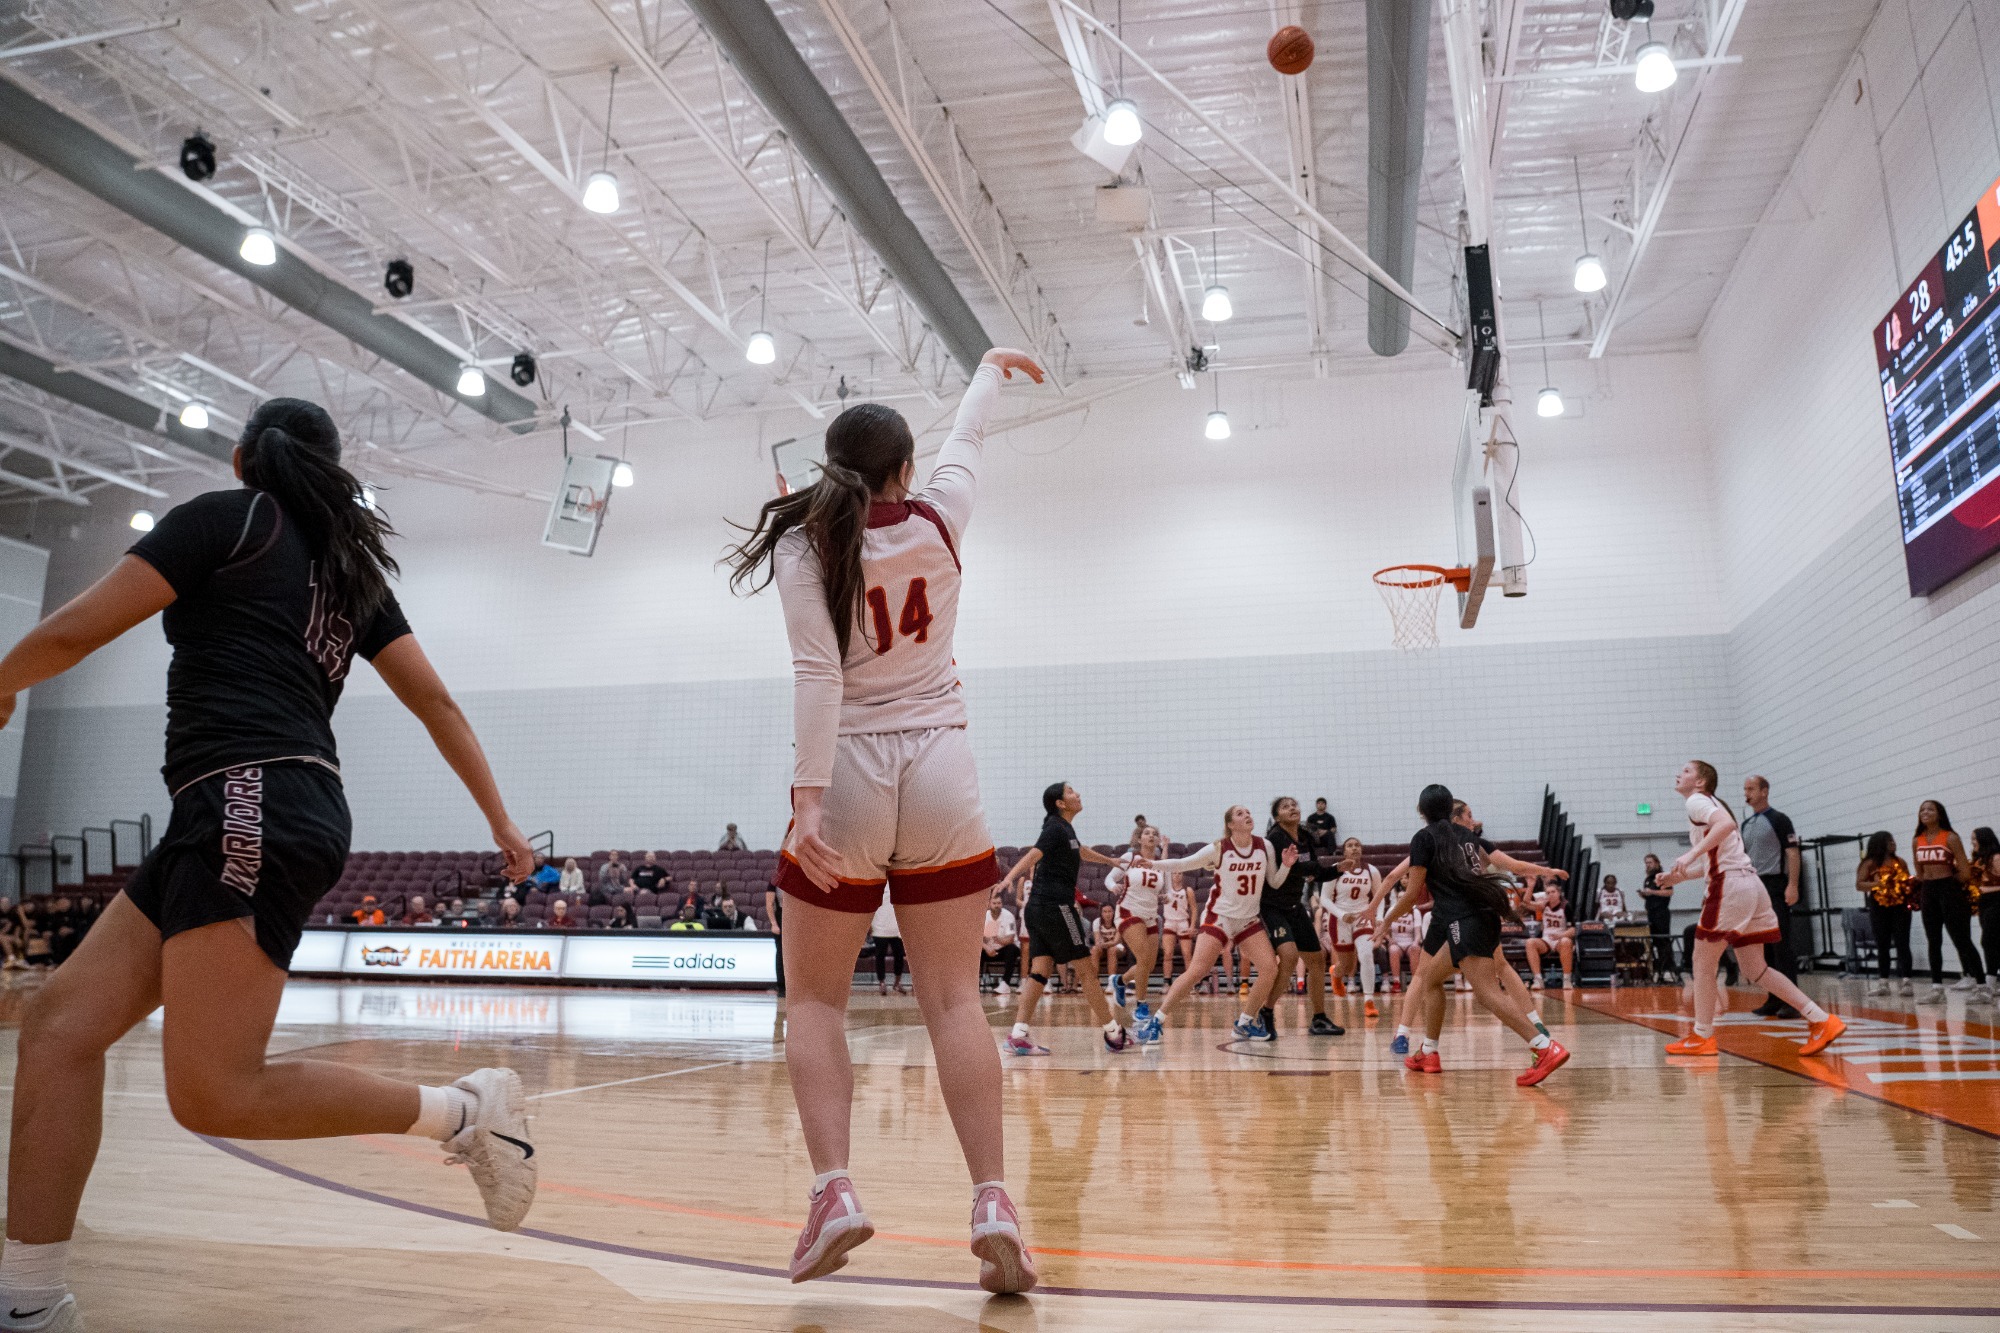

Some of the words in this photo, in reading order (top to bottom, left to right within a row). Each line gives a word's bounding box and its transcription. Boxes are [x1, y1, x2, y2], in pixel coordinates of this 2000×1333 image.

[1945, 220, 1976, 272] 45.5
[1909, 280, 1931, 325] 28
[1939, 317, 1954, 345] 28
[865, 576, 934, 656] 14
[221, 766, 263, 897] WRIORS
[1141, 871, 1159, 889] 12
[1237, 874, 1257, 896] 31
[1171, 899, 1178, 911] 4
[1350, 887, 1361, 900] 0
[418, 948, 476, 968] FAITH
[480, 951, 552, 971] ARENA
[673, 953, 736, 969] adidas
